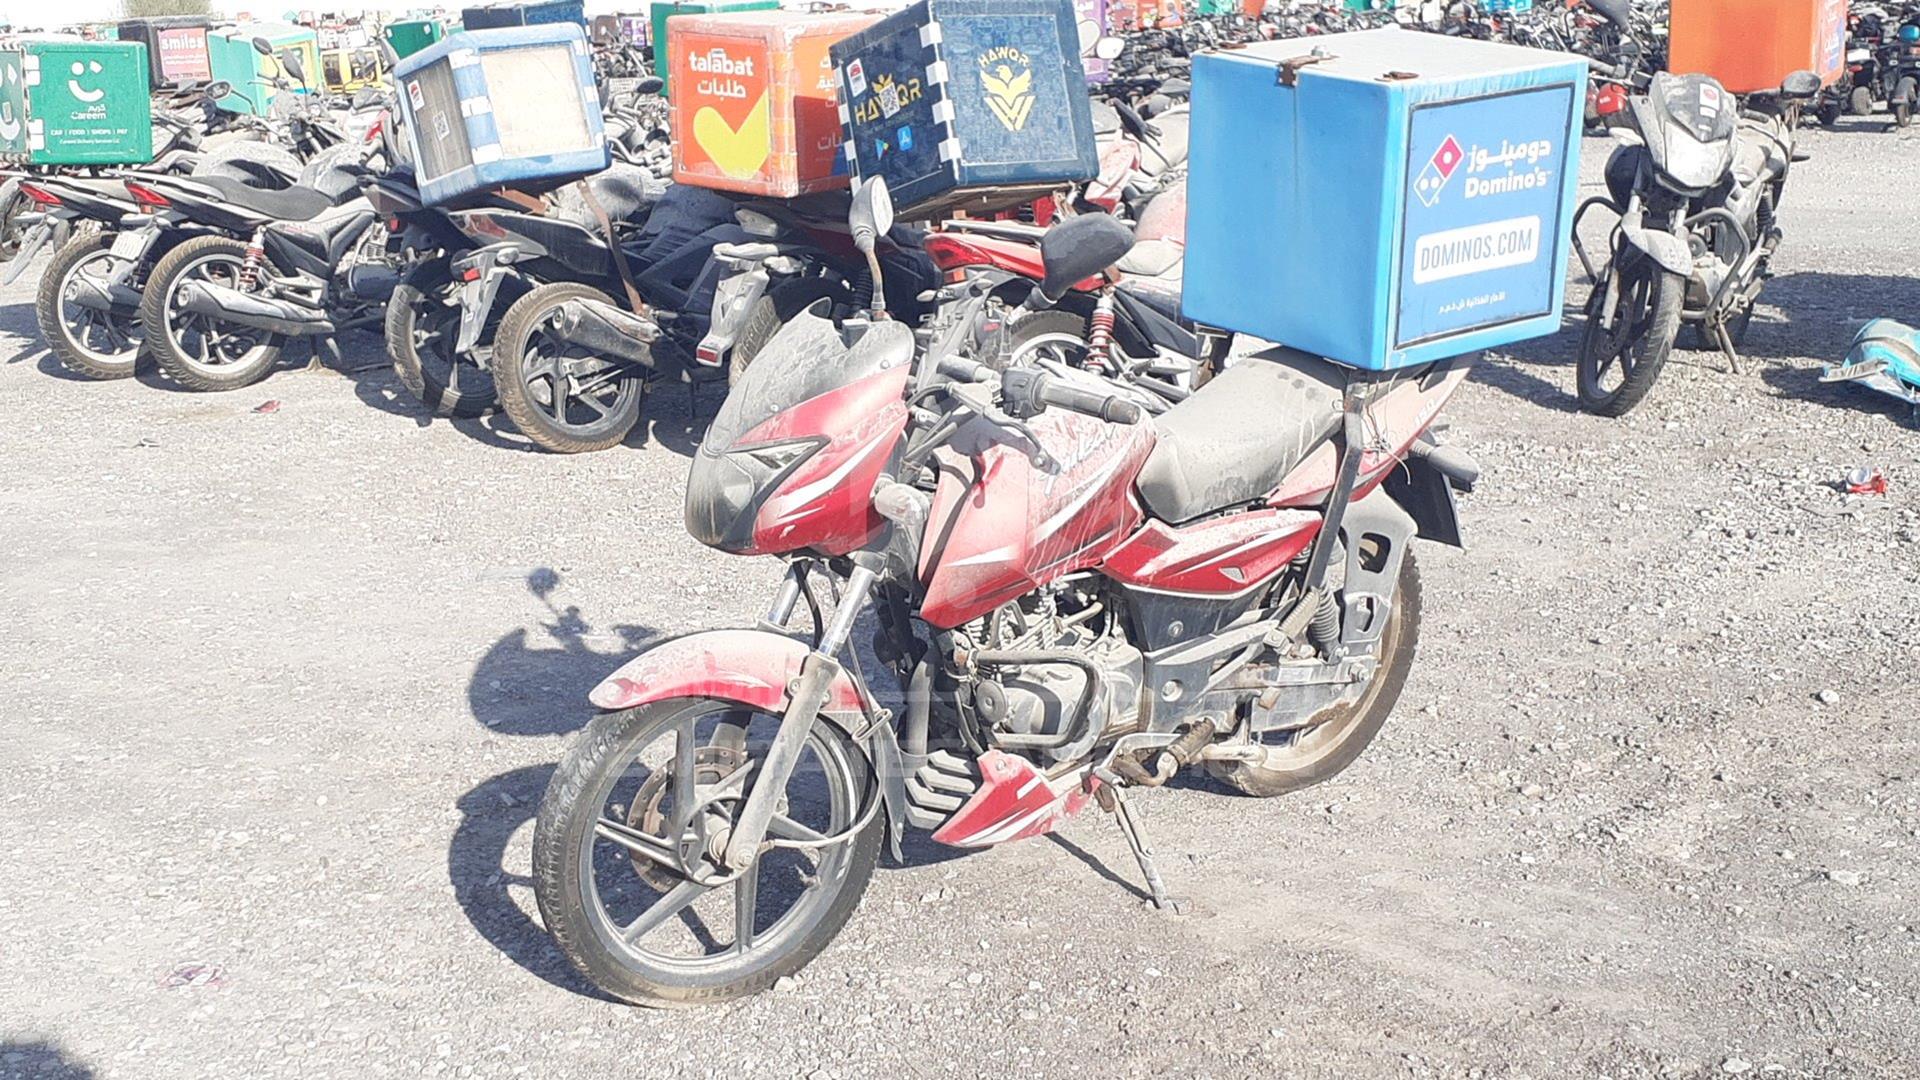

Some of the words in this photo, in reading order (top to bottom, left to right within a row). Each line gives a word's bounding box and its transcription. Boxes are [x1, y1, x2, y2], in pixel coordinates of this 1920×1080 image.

[161, 32, 204, 50] smiles
[688, 48, 754, 77] talabat
[976, 46, 1030, 68] HAWQR
[697, 78, 746, 102] طلبات
[853, 77, 923, 126] HAQR
[70, 111, 107, 121] Careem
[1420, 228, 1534, 272] DOMINOS.COM
